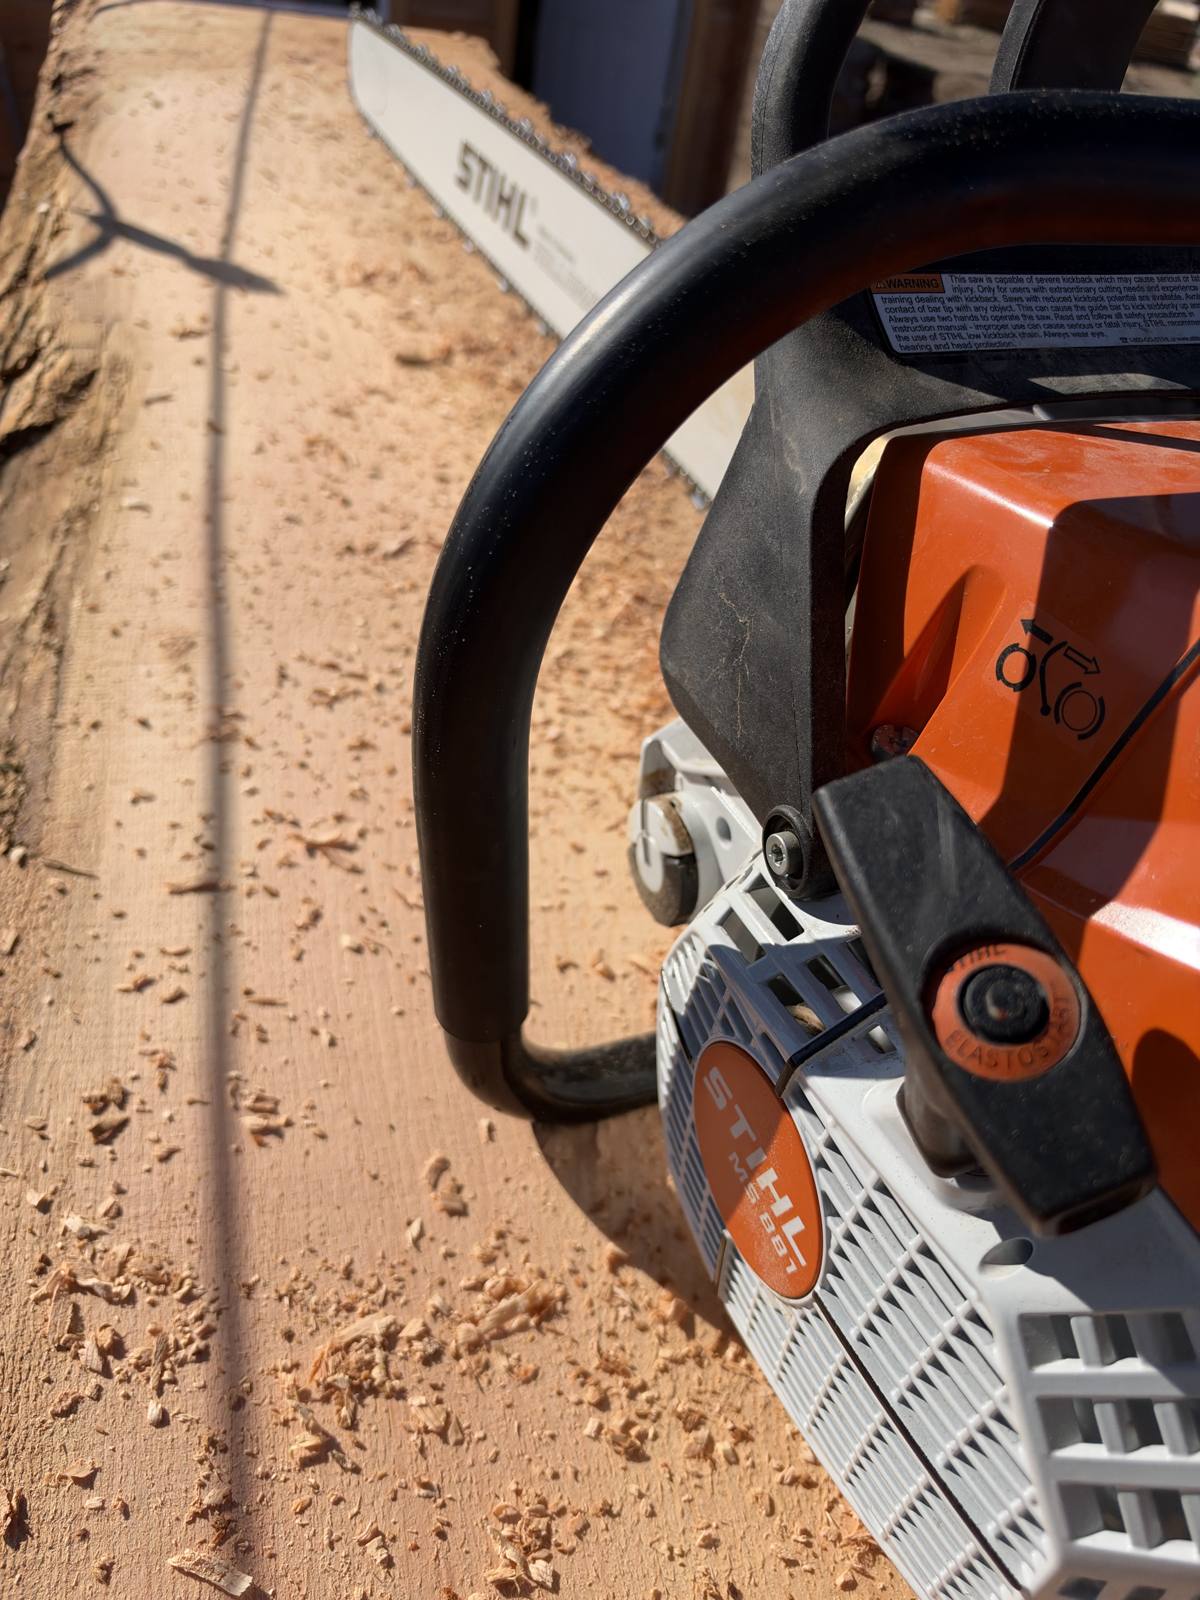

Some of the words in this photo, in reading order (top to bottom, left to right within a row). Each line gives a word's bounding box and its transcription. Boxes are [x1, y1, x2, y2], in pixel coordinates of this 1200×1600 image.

[455, 139, 530, 249] STIHL
[886, 278, 939, 289] WARNING
[950, 275, 967, 284] This
[995, 275, 1024, 286] capable
[1061, 275, 1093, 284] kickback
[1095, 276, 1115, 284] which
[1116, 277, 1131, 285] may
[1157, 275, 1181, 283] serious
[977, 285, 996, 296] Only
[1031, 285, 1048, 293] with
[1049, 285, 1097, 295] extraordinary
[1098, 285, 1122, 294] cutting
[1123, 285, 1145, 293] needs
[1146, 284, 1160, 292] and
[881, 295, 913, 305] training
[914, 295, 945, 305] dealing
[946, 294, 963, 303] with
[1001, 294, 1024, 303] Saws
[1025, 294, 1041, 302] with
[1041, 294, 1073, 303] reduced
[1073, 293, 1105, 302] kickback
[1106, 293, 1137, 304] potential
[885, 305, 915, 314] contact
[927, 304, 941, 313] bar
[955, 303, 972, 313] with
[973, 305, 988, 314] any
[1016, 303, 1033, 312] This
[1034, 304, 1049, 312] can
[1050, 304, 1072, 312] cause
[1073, 303, 1087, 312] the
[1088, 303, 1108, 314] guide
[1132, 302, 1145, 310] kick
[1147, 301, 1179, 311] suddenly
[888, 314, 919, 325] Always
[920, 315, 936, 323] use
[937, 313, 953, 322] two
[953, 313, 980, 322] hands
[990, 313, 1021, 323] operate
[1021, 313, 1034, 321] the
[1053, 312, 1074, 321] Read
[1075, 312, 1090, 321] and
[1091, 312, 1113, 320] follow
[1124, 311, 1147, 321] safety
[1147, 311, 1188, 321] precautions
[891, 323, 935, 333] instruction
[936, 323, 968, 332] manual
[1010, 323, 1026, 331] use
[1066, 321, 1093, 330] serious
[1104, 319, 1121, 328] fatal
[895, 333, 911, 342] the
[912, 334, 928, 342] use
[938, 331, 967, 341] STIHL
[967, 331, 982, 340] low
[982, 330, 1018, 339] kickback
[1043, 329, 1070, 340] Always
[899, 342, 933, 352] hearing
[933, 341, 950, 350] and
[950, 341, 973, 350] head
[703, 1066, 807, 1267] STIHL
[729, 1152, 761, 1204] MS
[759, 1211, 798, 1275] 881
